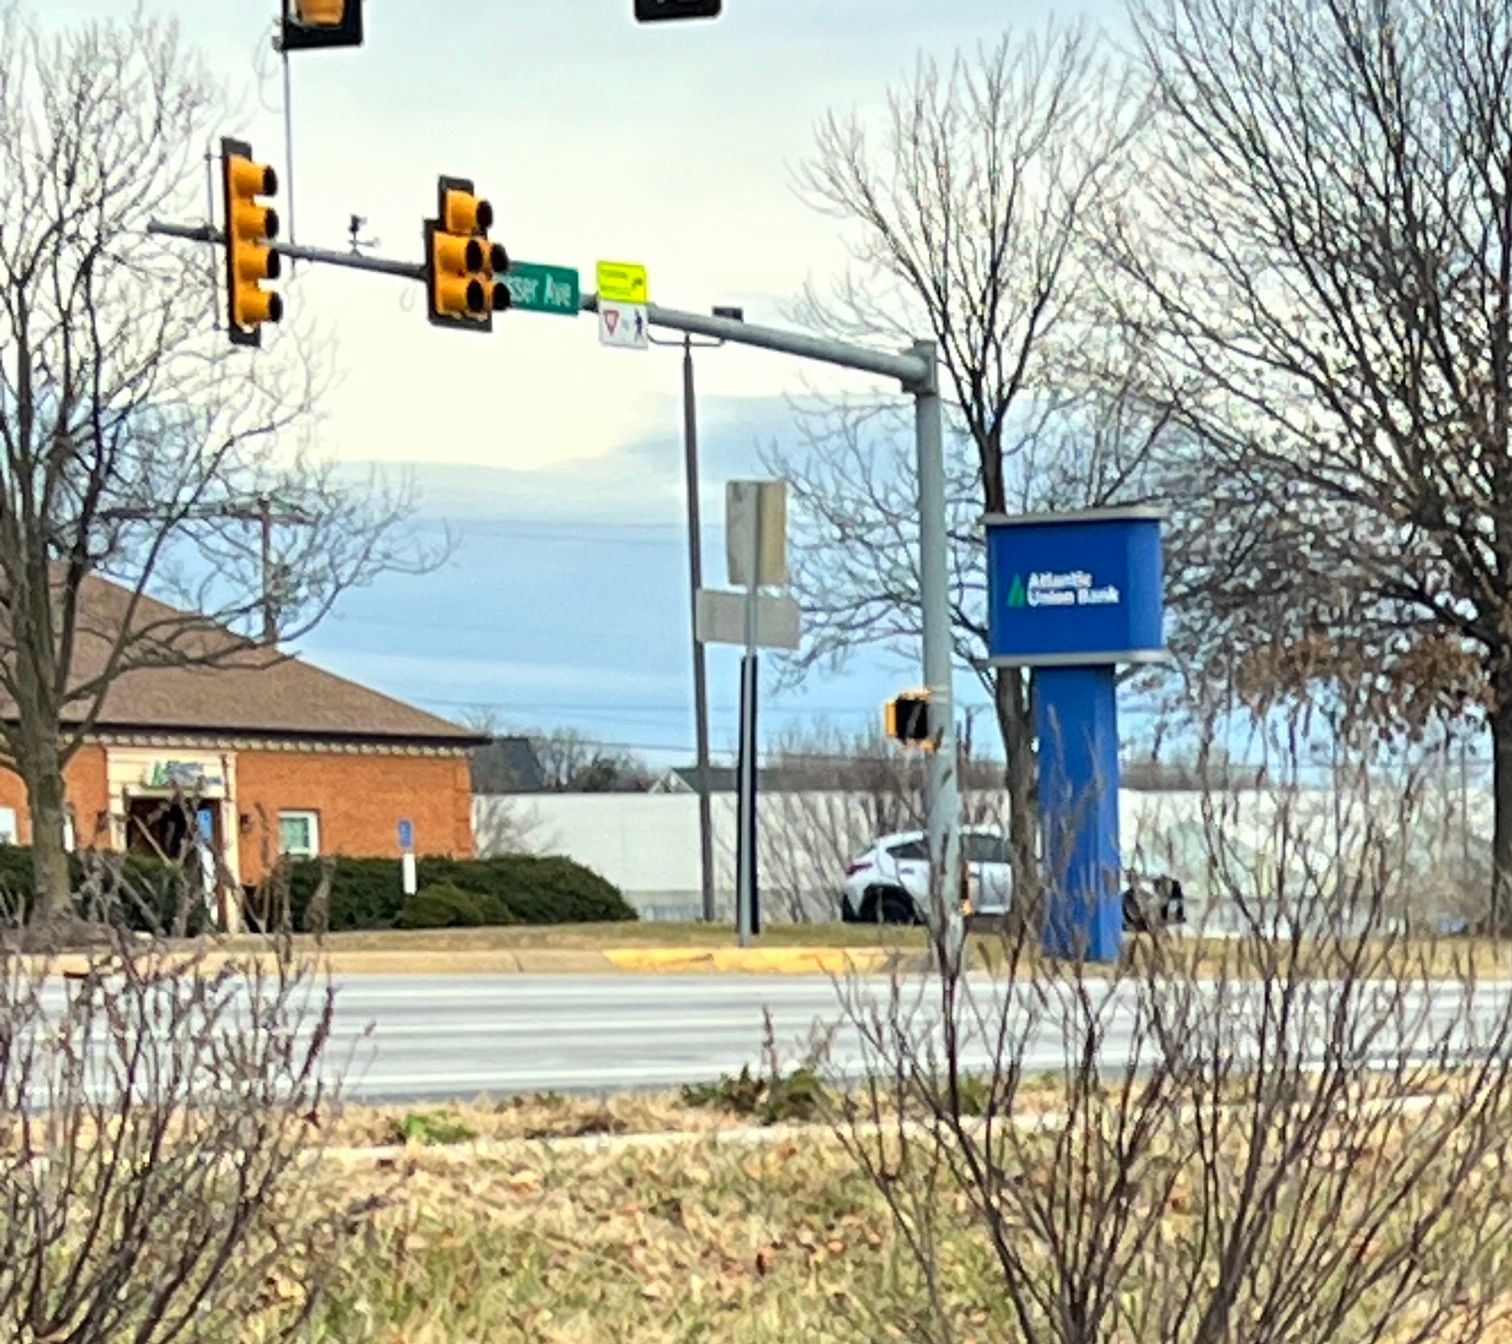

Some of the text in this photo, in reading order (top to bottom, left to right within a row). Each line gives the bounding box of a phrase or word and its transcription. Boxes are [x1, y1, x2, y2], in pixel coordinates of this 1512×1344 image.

[543, 272, 572, 308] Ave
[1029, 570, 1093, 589] Atlantic
[1027, 584, 1120, 607] Union Bank
